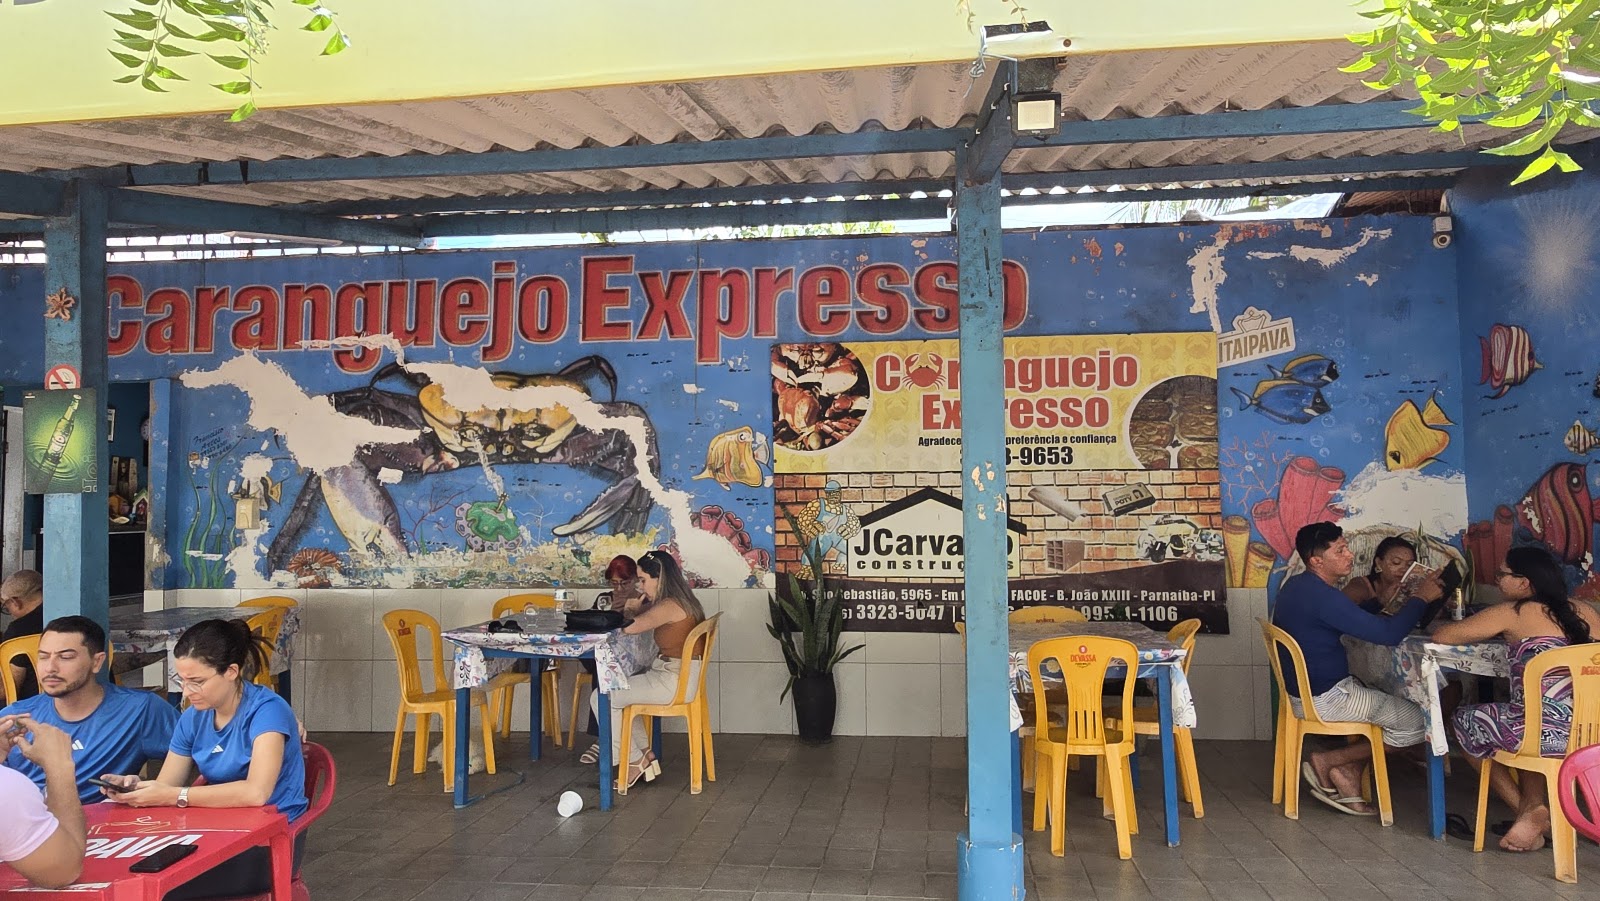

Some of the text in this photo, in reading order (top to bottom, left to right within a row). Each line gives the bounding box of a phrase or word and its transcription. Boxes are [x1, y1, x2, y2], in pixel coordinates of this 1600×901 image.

[107, 261, 568, 370] Caranguejo
[1218, 327, 1291, 363] ITAIPAVA
[922, 395, 1109, 429] Exesso
[857, 560, 1013, 572] construçs
[901, 589, 932, 600] 5965
[941, 590, 958, 600] Em
[1011, 590, 1047, 601] FACOE
[1057, 590, 1068, 601] B.
[1071, 589, 1098, 601] João
[1102, 590, 1130, 601] XXIII
[856, 604, 945, 620] 3323-5047
